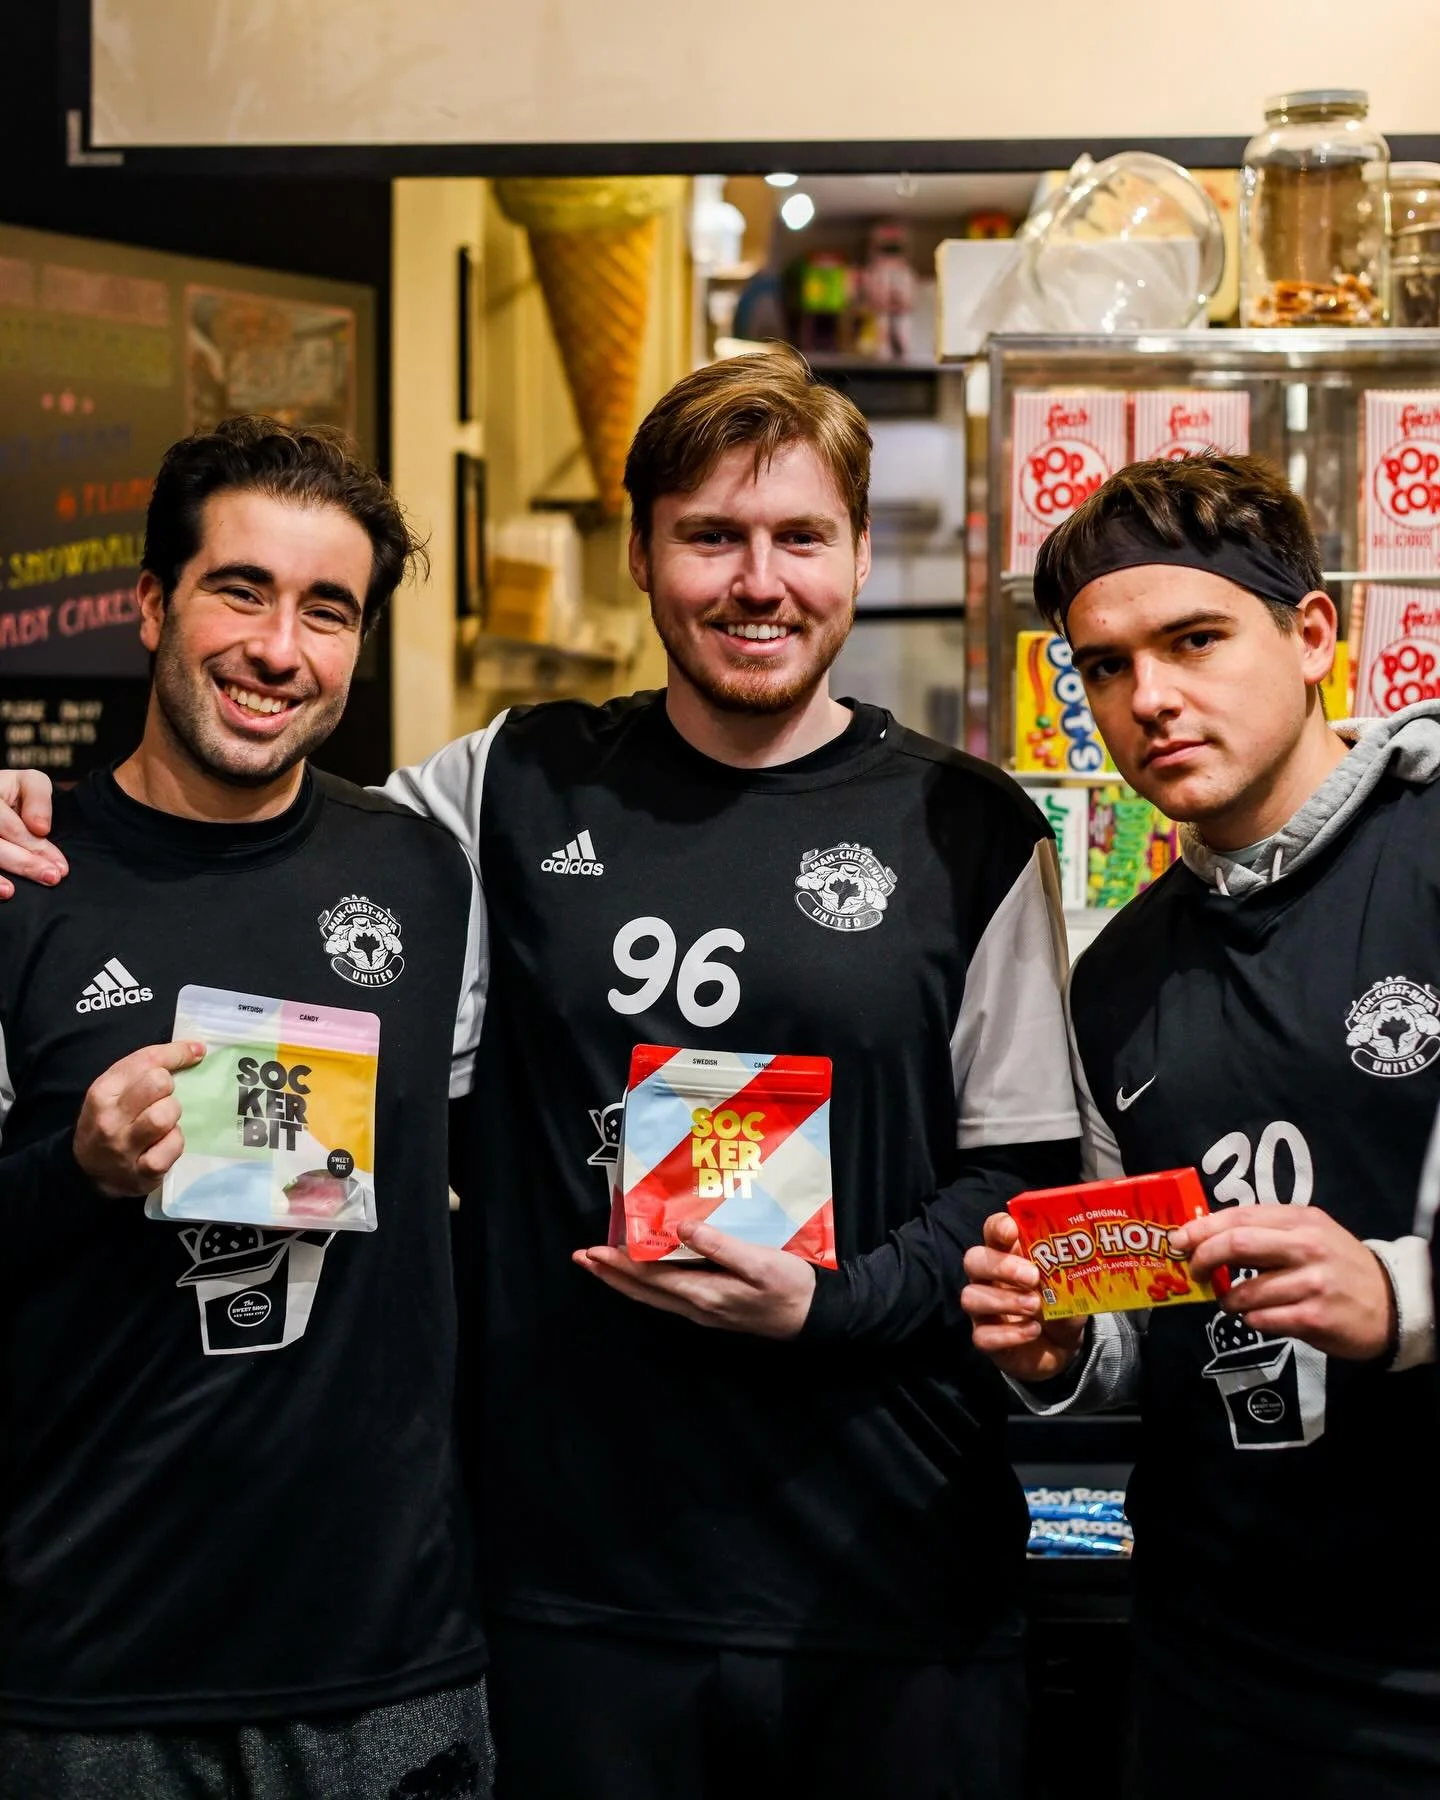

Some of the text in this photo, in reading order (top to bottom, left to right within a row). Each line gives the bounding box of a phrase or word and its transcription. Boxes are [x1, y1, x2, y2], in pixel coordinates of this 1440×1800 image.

[1385, 447, 1439, 486] POP
[1391, 482, 1440, 515] COR
[541, 858, 605, 876] adidas
[810, 850, 889, 891] MAN-CHEST-HAIR
[328, 902, 397, 933] MAN-CHEST-HAIR
[811, 907, 861, 928] UNITED
[352, 968, 394, 984] UNITED
[607, 916, 746, 1028] 96
[75, 987, 154, 1014] adidas
[238, 1004, 320, 1022] SWEDISH CANDY
[236, 1057, 313, 1095] SOC
[692, 1058, 718, 1066] SWEDISH
[1372, 1054, 1426, 1074] UNITED
[237, 1086, 309, 1124] KER
[243, 1117, 303, 1152] BIT
[691, 1107, 767, 1142] SOC
[331, 1156, 350, 1165] SWEET
[691, 1138, 764, 1171] KER
[1201, 1120, 1314, 1208] 30
[698, 1168, 758, 1199] BIT
[1068, 1209, 1129, 1225] THE ORIGINAL
[1031, 1231, 1094, 1272] RED
[1067, 1264, 1102, 1281] CINNAMON
[1102, 1260, 1140, 1270] FLAVORED
